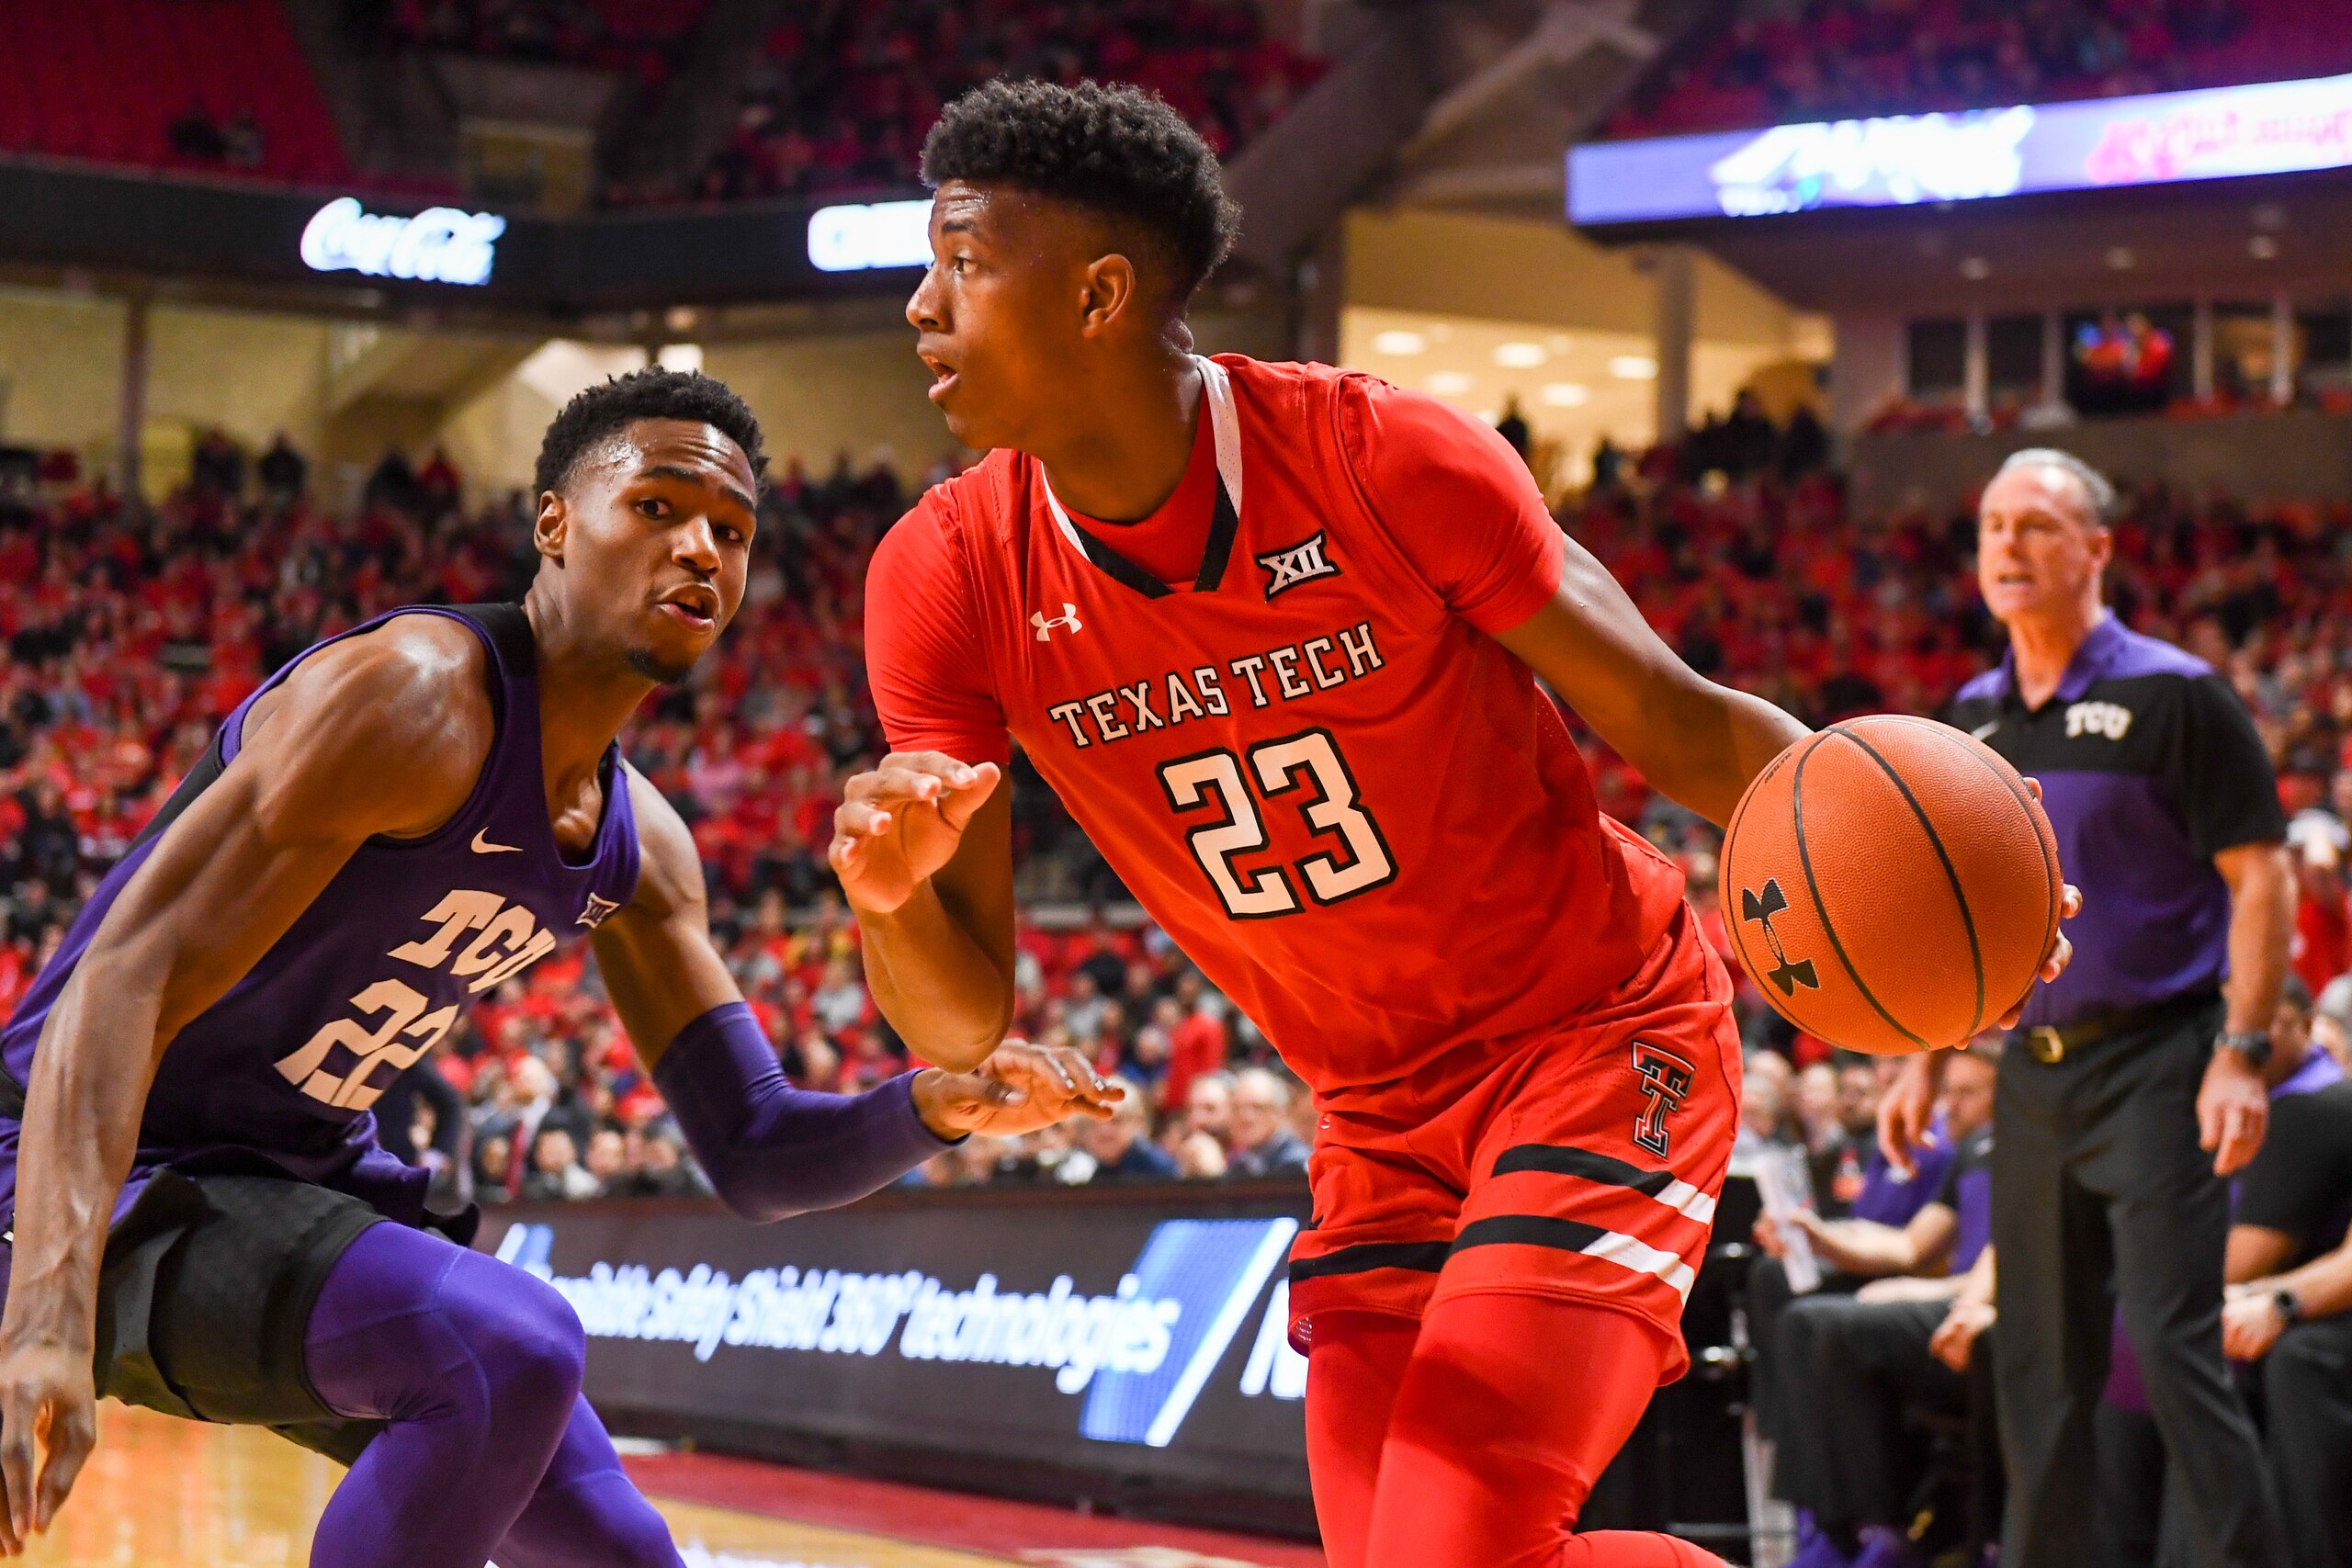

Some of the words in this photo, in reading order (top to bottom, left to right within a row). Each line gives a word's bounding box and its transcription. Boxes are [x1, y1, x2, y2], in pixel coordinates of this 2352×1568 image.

[1258, 532, 1340, 600] XII
[1048, 664, 1231, 749] TEXAS
[1230, 621, 1385, 709] TECH
[2064, 701, 2132, 742] TCU
[1155, 727, 1398, 920] 23
[273, 978, 459, 1111] 22
[899, 1272, 1182, 1394] technologies
